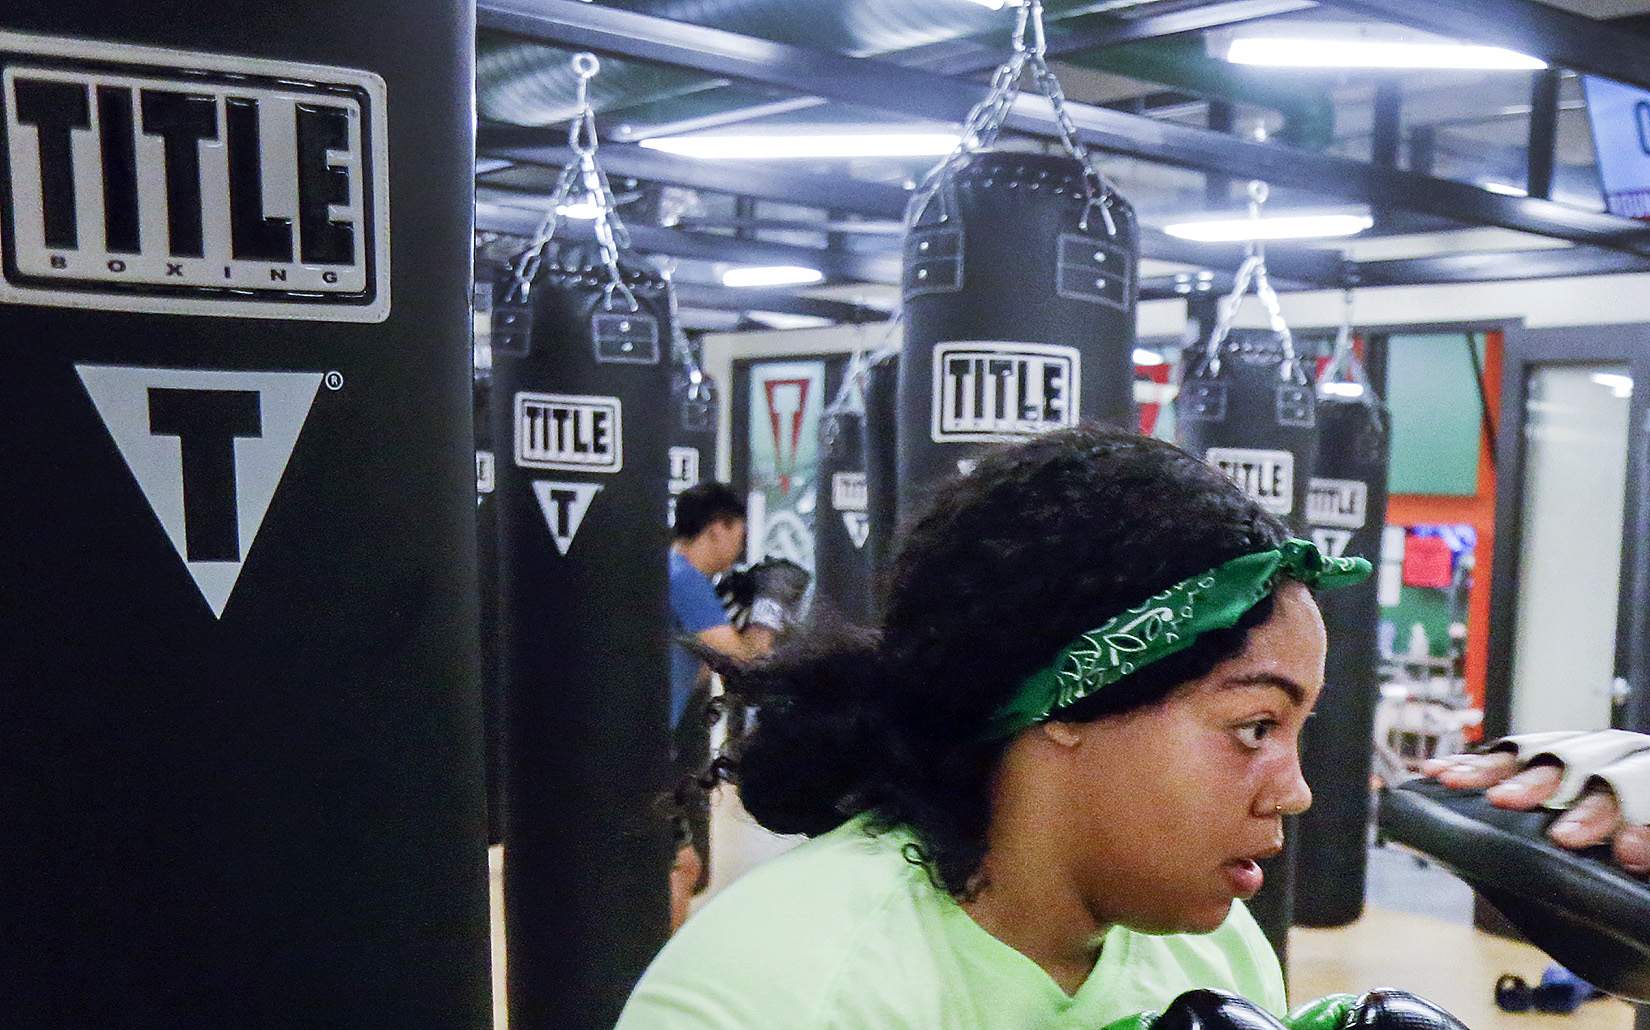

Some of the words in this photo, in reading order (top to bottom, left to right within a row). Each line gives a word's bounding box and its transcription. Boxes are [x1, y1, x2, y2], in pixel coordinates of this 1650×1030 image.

[14, 77, 355, 266] TITLE
[50, 255, 339, 284] BOXING
[949, 359, 1062, 423] TITLE
[526, 405, 608, 455] TITLE
[148, 386, 262, 563] T
[549, 488, 578, 538] T
